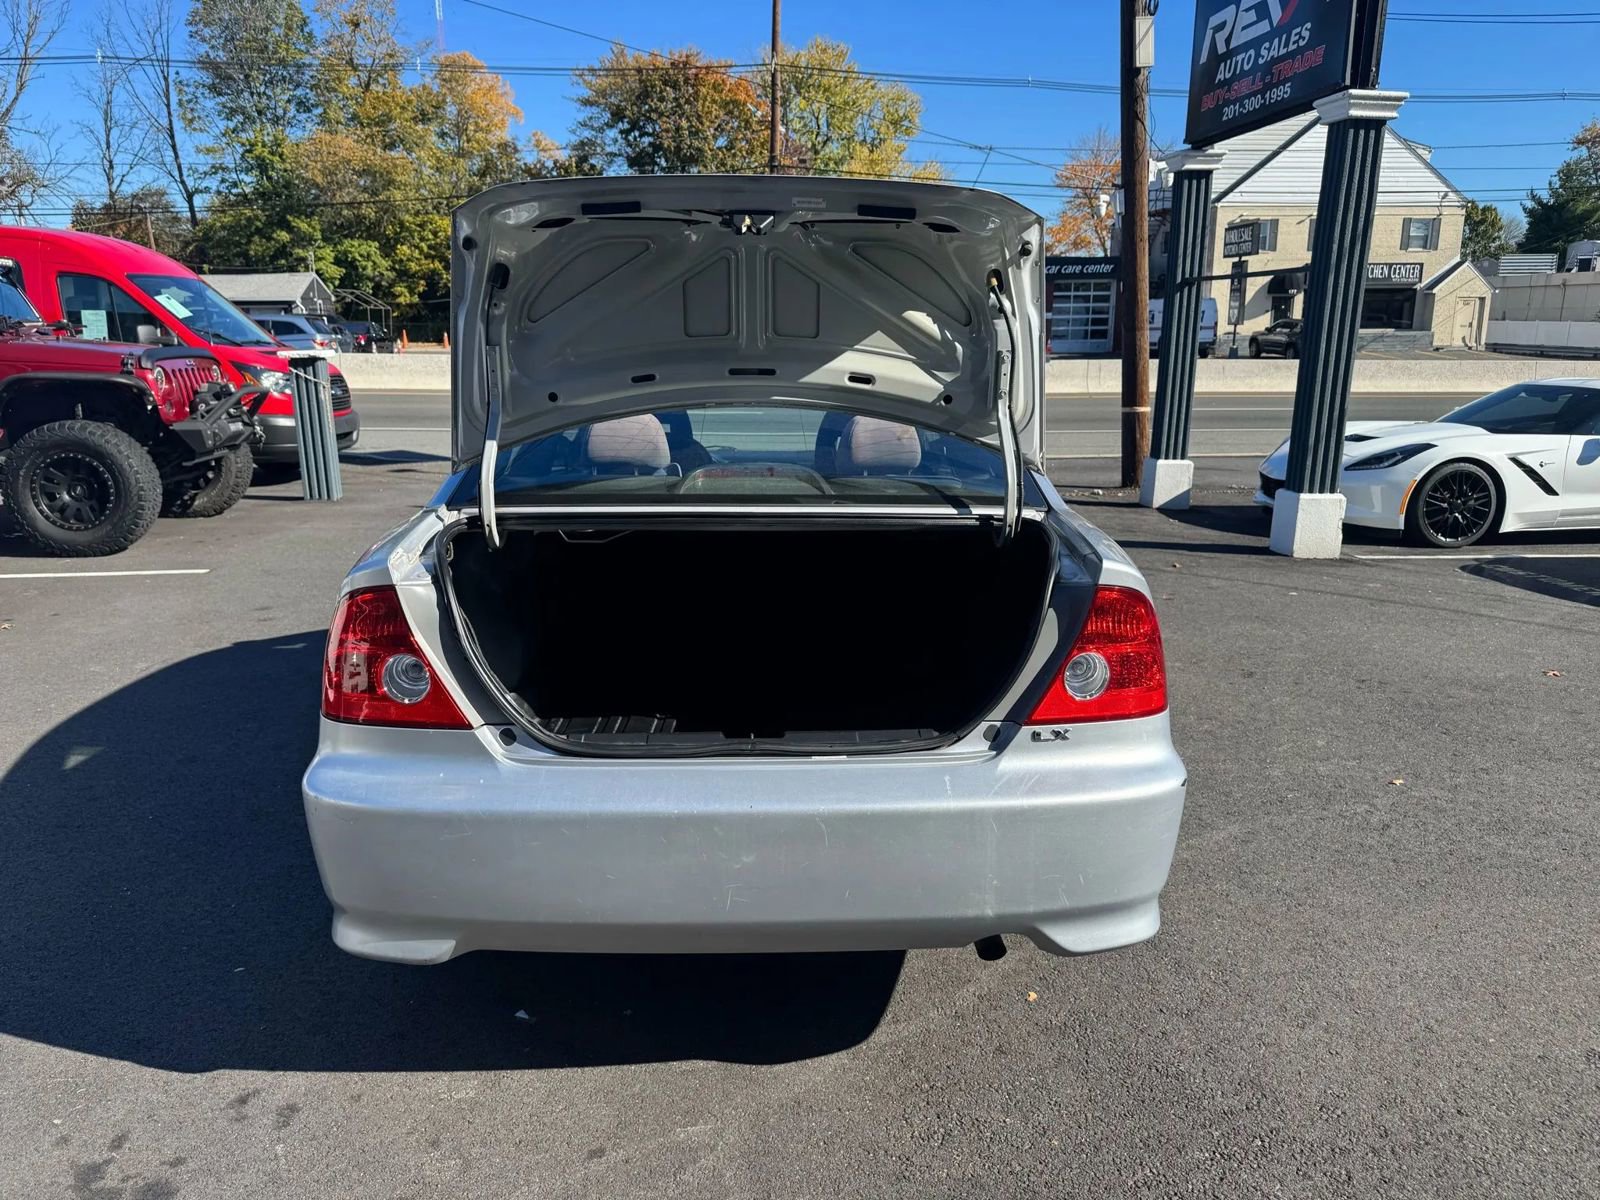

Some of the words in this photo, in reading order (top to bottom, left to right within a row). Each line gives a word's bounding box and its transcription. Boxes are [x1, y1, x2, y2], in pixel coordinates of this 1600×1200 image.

[1200, 0, 1299, 64] REV
[1215, 51, 1254, 84] AUTO
[1258, 22, 1312, 65] SALES
[1222, 82, 1292, 122] 201-300-1995
[1061, 264, 1082, 274] care
[1083, 263, 1115, 274] center
[1367, 264, 1389, 278] CHEN
[1391, 264, 1420, 278] CENTER
[1031, 729, 1072, 742] LX
